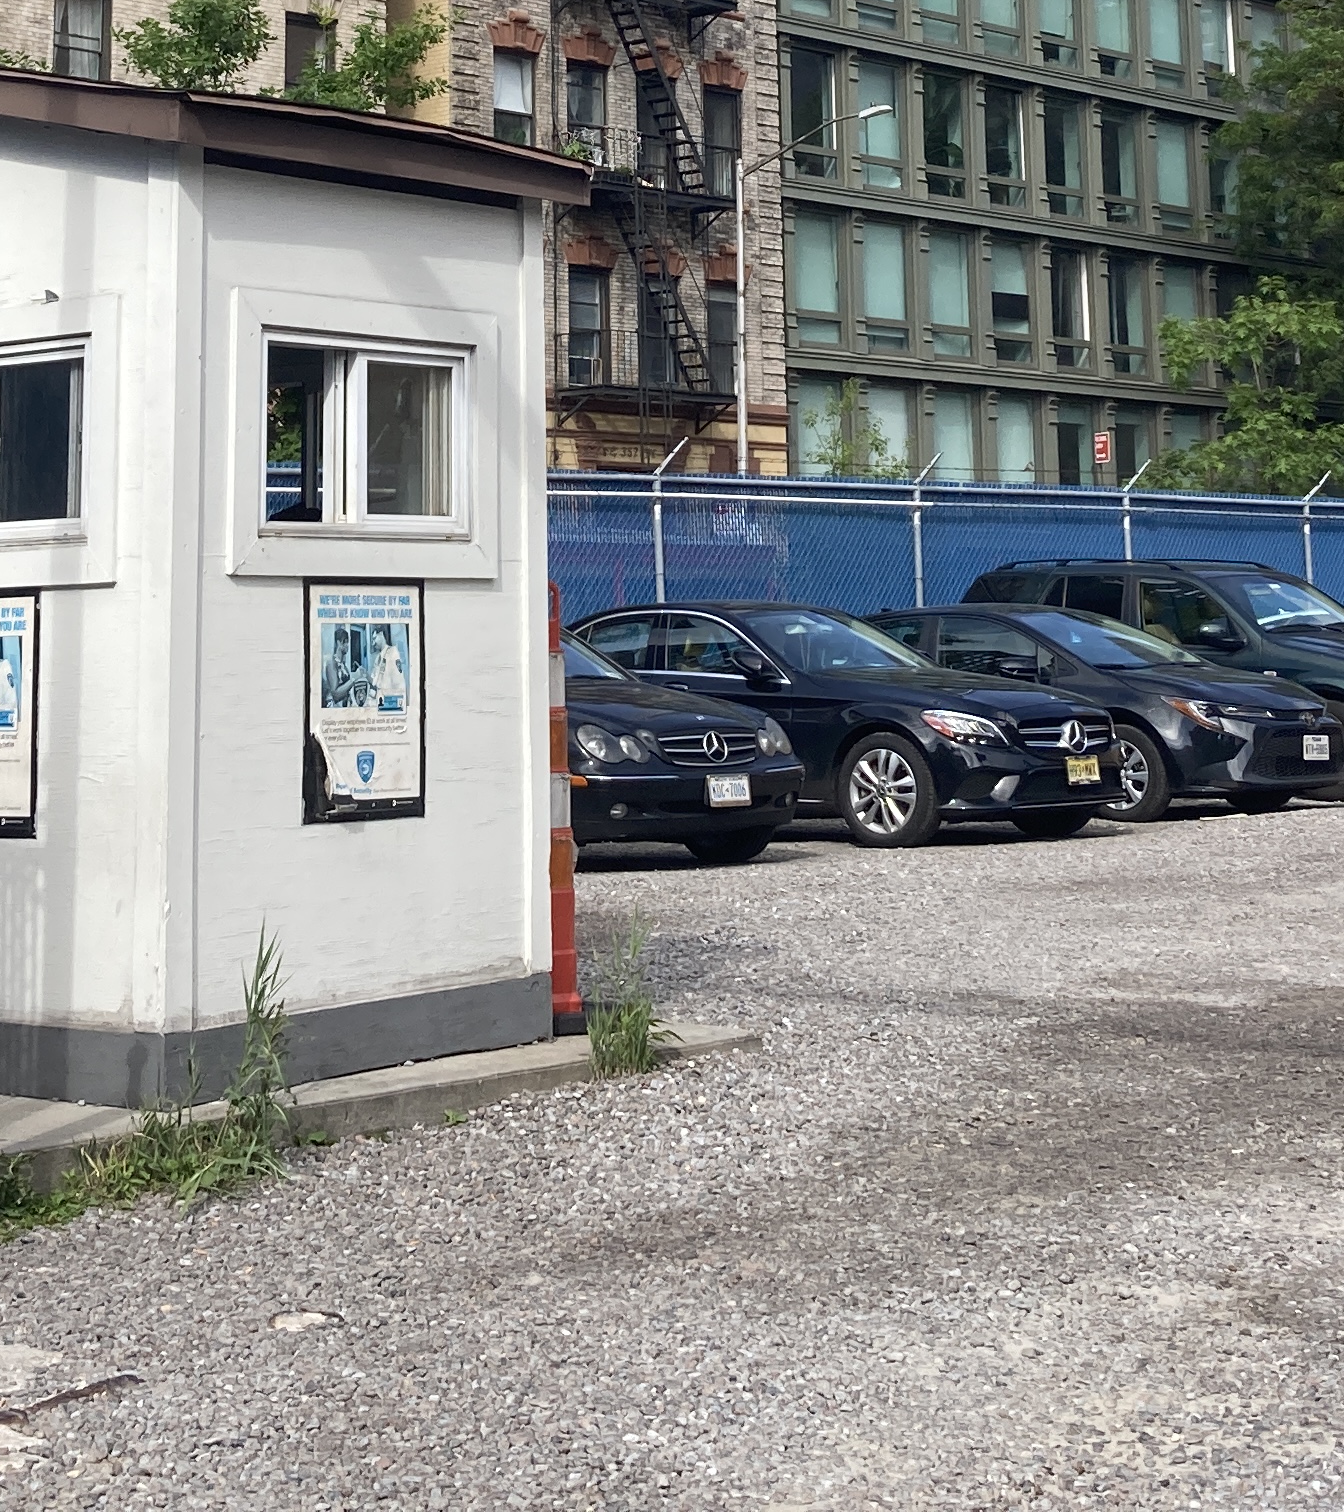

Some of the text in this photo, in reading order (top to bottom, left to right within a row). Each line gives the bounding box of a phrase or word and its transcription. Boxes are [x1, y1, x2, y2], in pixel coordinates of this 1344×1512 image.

[342, 594, 360, 605] MORE
[362, 595, 387, 605] SECURE
[1, 607, 10, 618] BY
[11, 607, 25, 617] FAR
[318, 608, 337, 618] WHEN
[350, 608, 370, 618] KNOW
[371, 608, 386, 618] WHO
[387, 609, 399, 618] YOU
[399, 609, 412, 618] ARE
[0, 620, 12, 631] YOU
[13, 620, 27, 630] ARE
